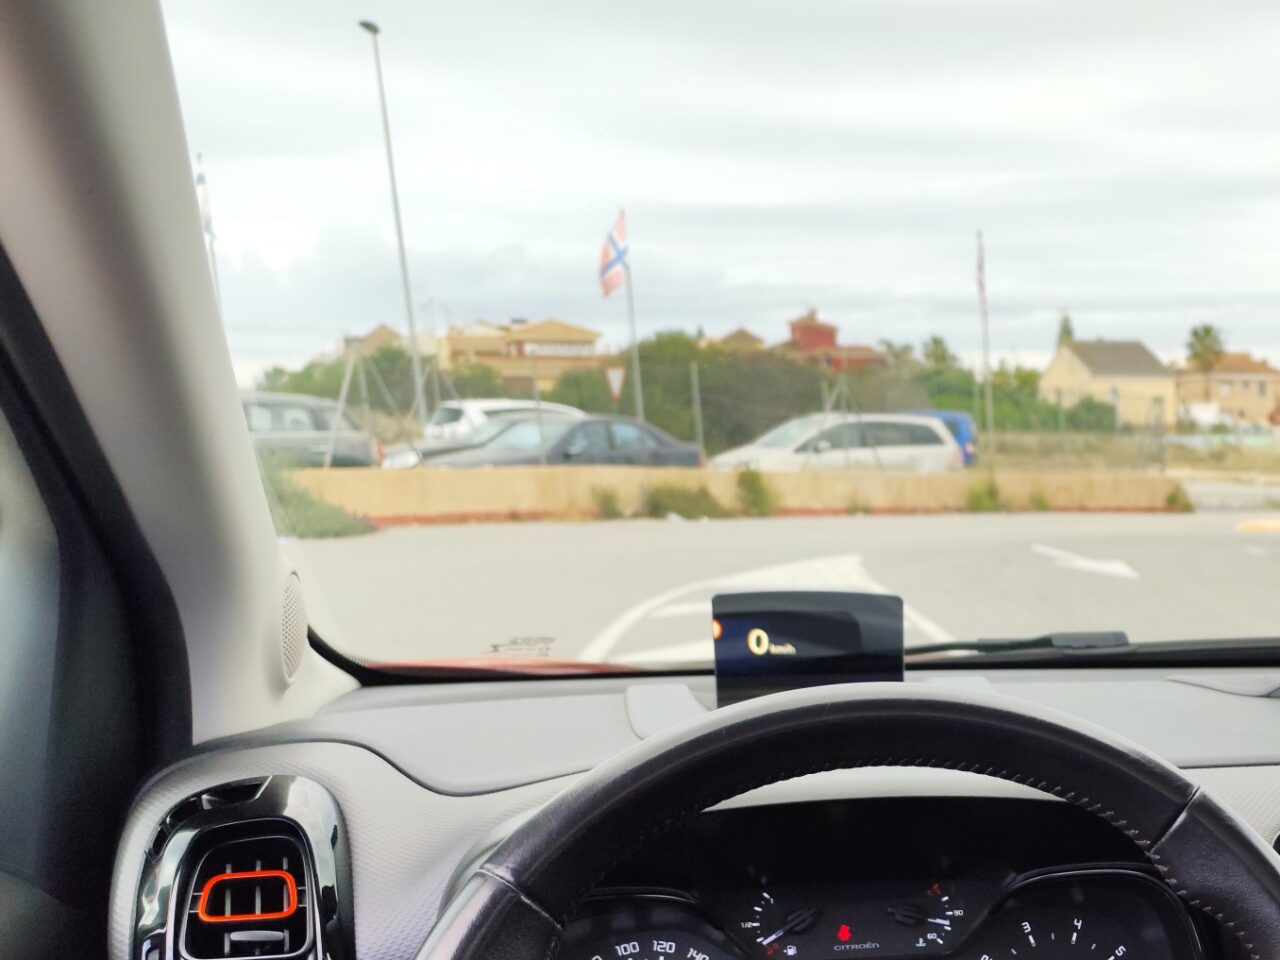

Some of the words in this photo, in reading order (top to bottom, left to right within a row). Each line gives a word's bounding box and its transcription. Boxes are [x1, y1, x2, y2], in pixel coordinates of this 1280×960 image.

[748, 628, 769, 656] 0
[953, 909, 964, 917] 90
[1021, 921, 1032, 933] 3
[1073, 918, 1083, 930] 4
[615, 941, 640, 956] 100
[652, 940, 676, 954] 120
[1115, 945, 1127, 957] 5
